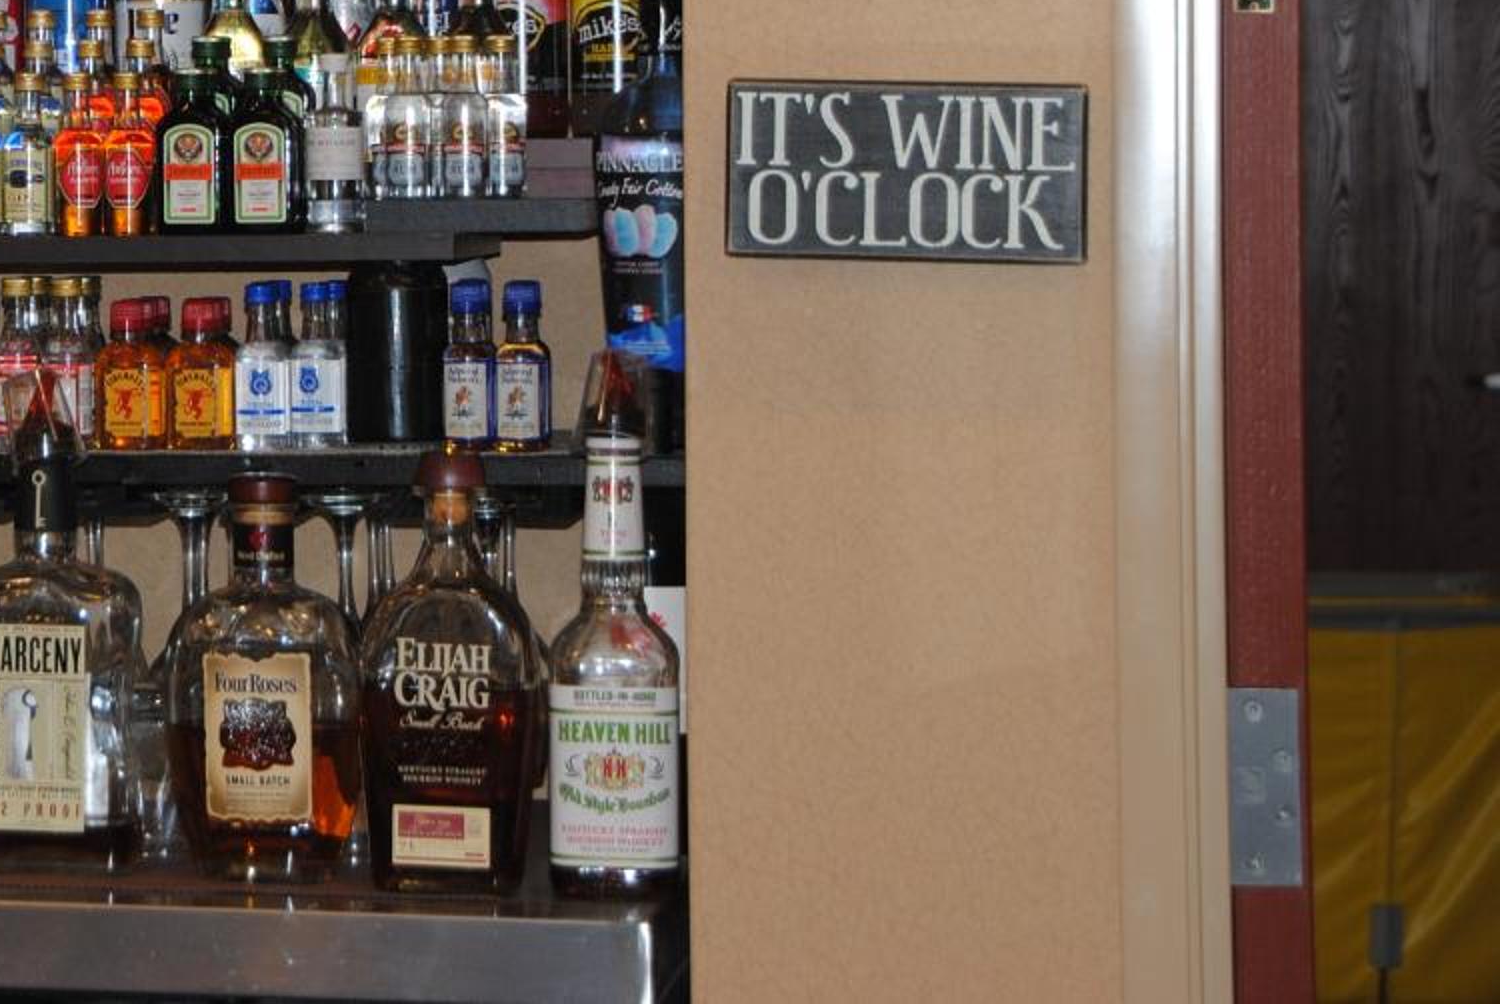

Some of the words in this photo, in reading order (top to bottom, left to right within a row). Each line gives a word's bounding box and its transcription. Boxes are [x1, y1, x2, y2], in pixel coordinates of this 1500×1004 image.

[736, 90, 855, 169] IT'S
[880, 94, 1076, 172] WINE
[747, 168, 1065, 251] O'CLOCK
[395, 637, 492, 677] ELIJAH
[393, 672, 491, 712] CRAIG
[557, 719, 630, 744] HEAVEN
[635, 721, 672, 745] HILL
